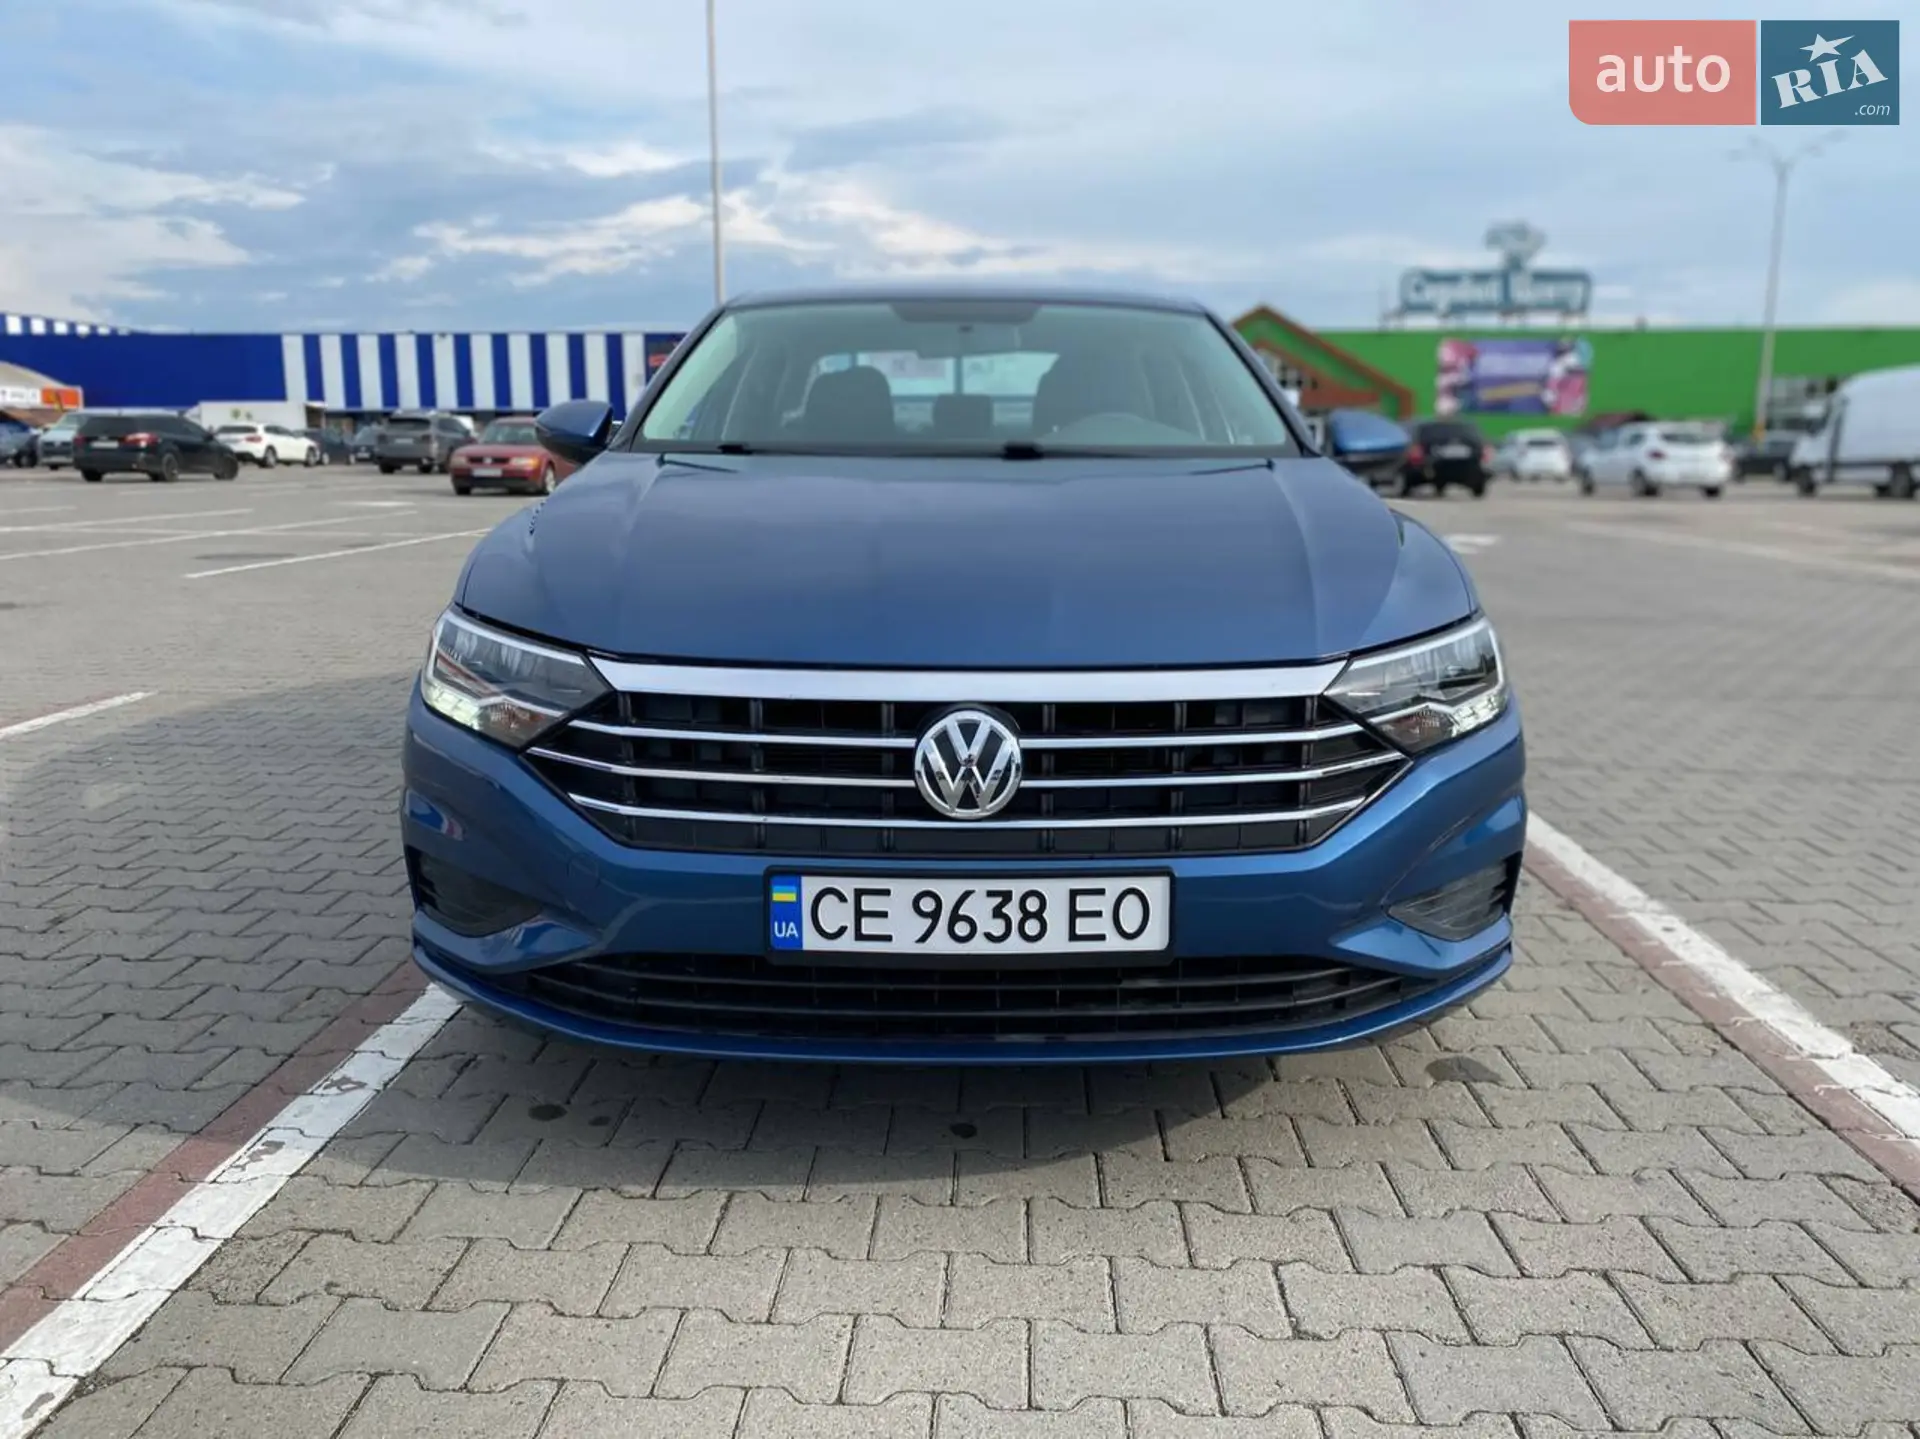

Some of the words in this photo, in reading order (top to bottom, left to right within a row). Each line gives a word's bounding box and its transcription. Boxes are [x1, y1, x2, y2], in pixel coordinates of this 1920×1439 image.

[774, 921, 799, 938] UA
[810, 886, 893, 943] CE
[911, 889, 1048, 944] 9638
[1067, 887, 1151, 942] EO
